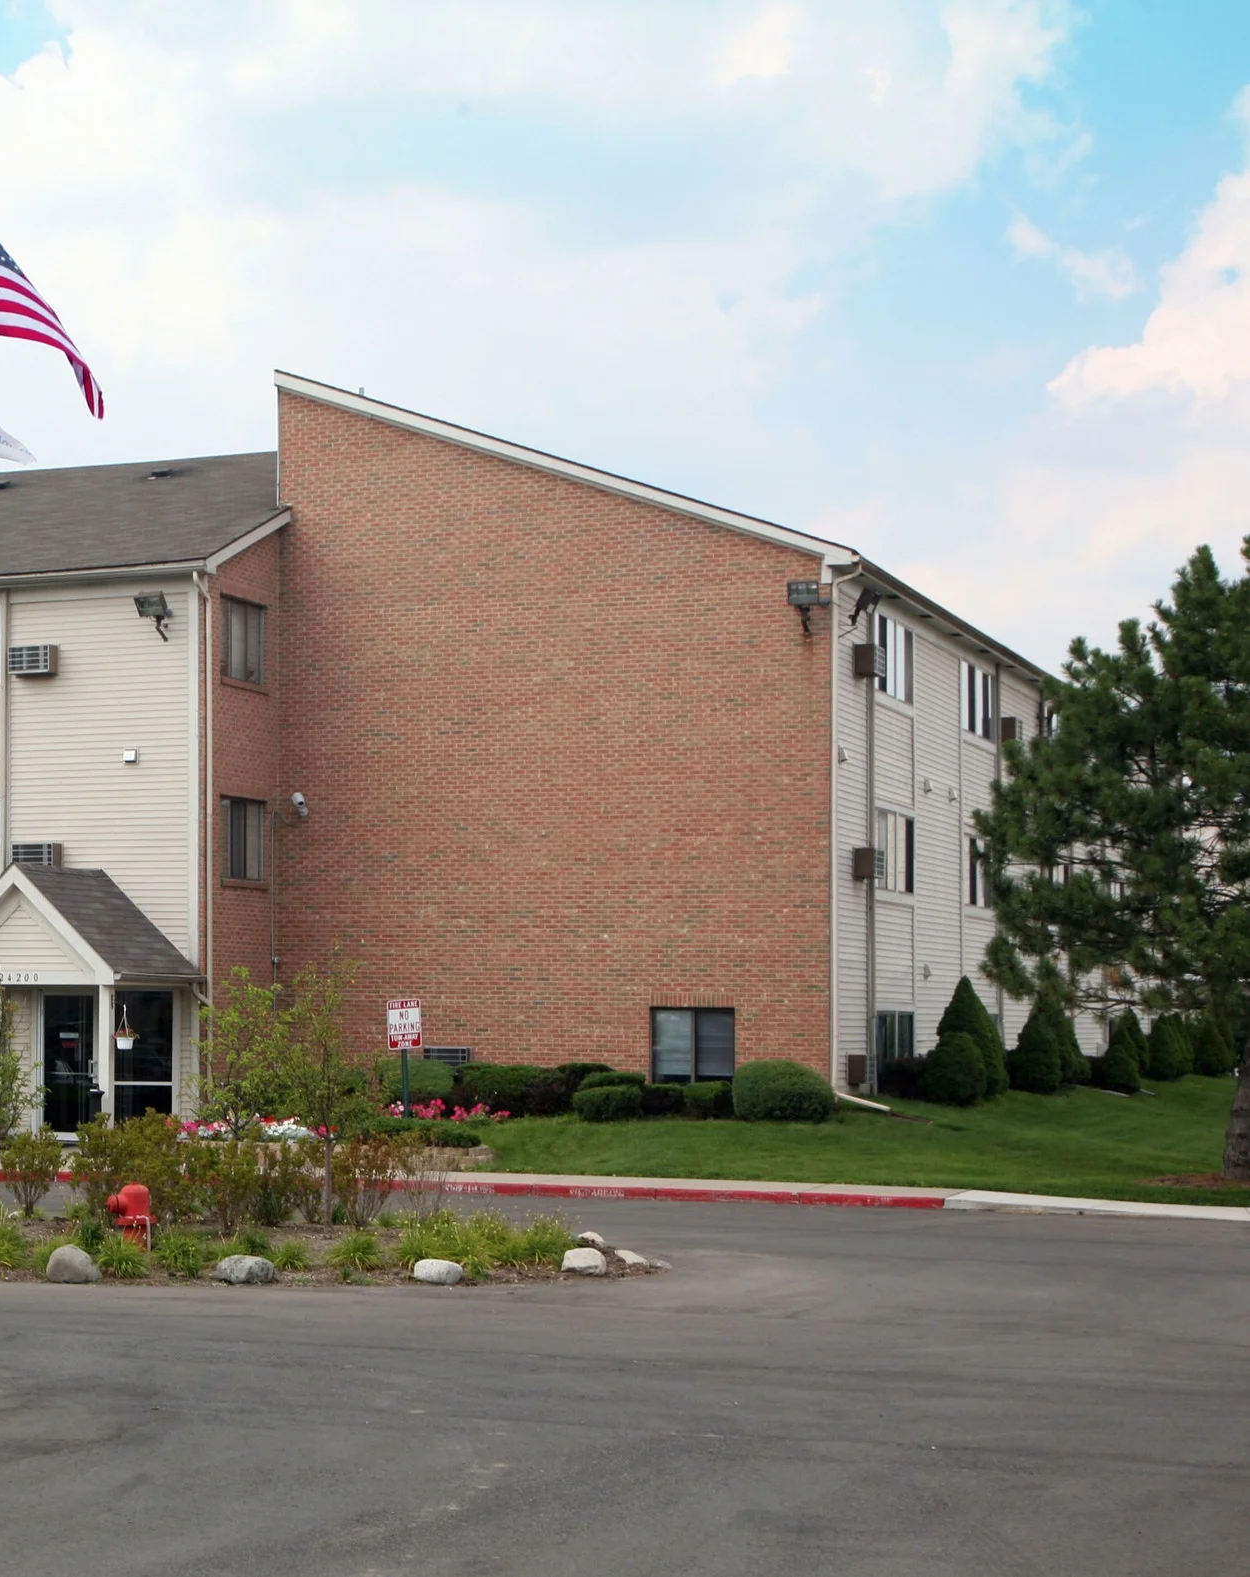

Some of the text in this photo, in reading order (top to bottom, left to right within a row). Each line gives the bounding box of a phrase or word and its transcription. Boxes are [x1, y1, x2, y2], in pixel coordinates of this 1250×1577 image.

[0, 973, 39, 983] 24200
[399, 1010, 409, 1020] NO
[389, 1021, 420, 1033] PARKING
